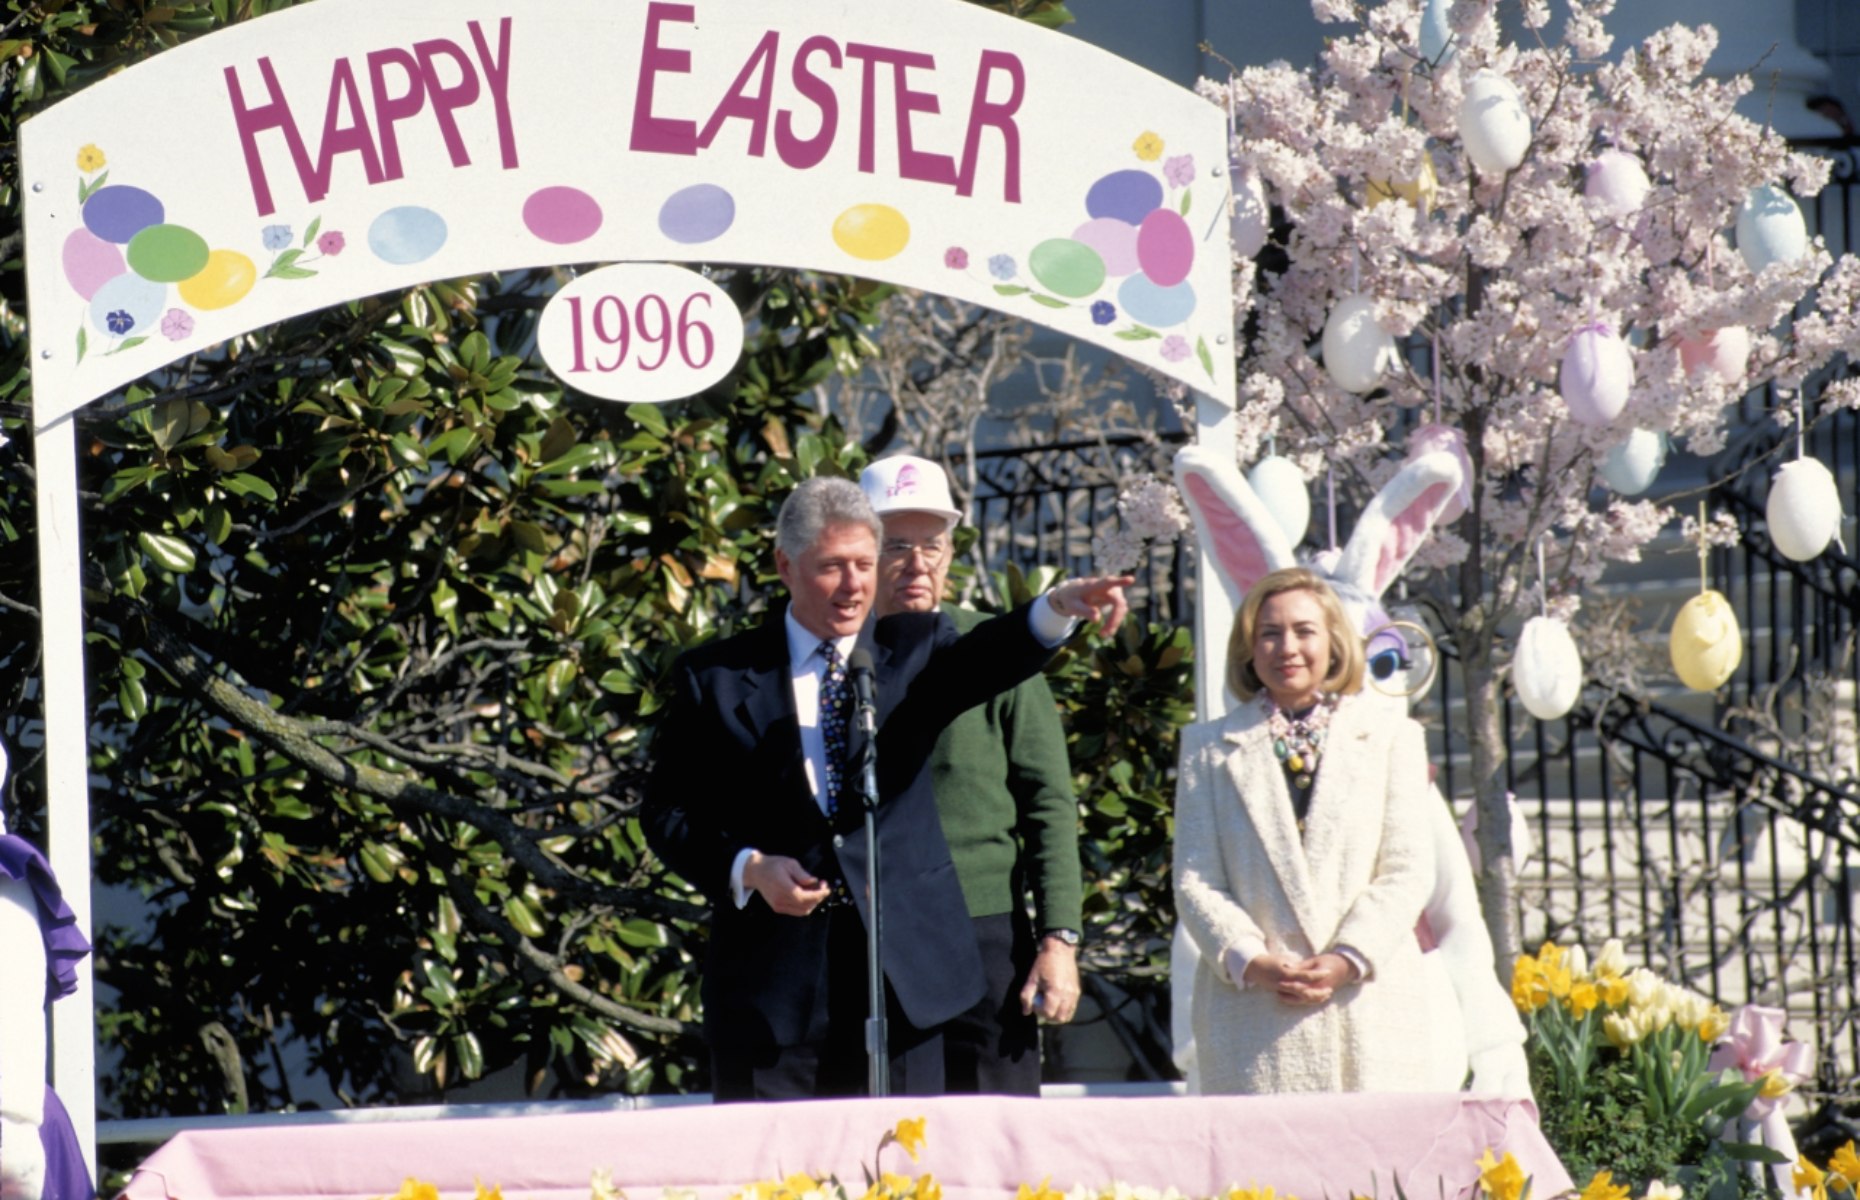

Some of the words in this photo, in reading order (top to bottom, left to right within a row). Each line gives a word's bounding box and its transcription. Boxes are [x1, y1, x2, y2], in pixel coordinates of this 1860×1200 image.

[224, 16, 519, 216] HAPPY
[629, 2, 1025, 203] EASTER
[563, 291, 715, 373] 1996
